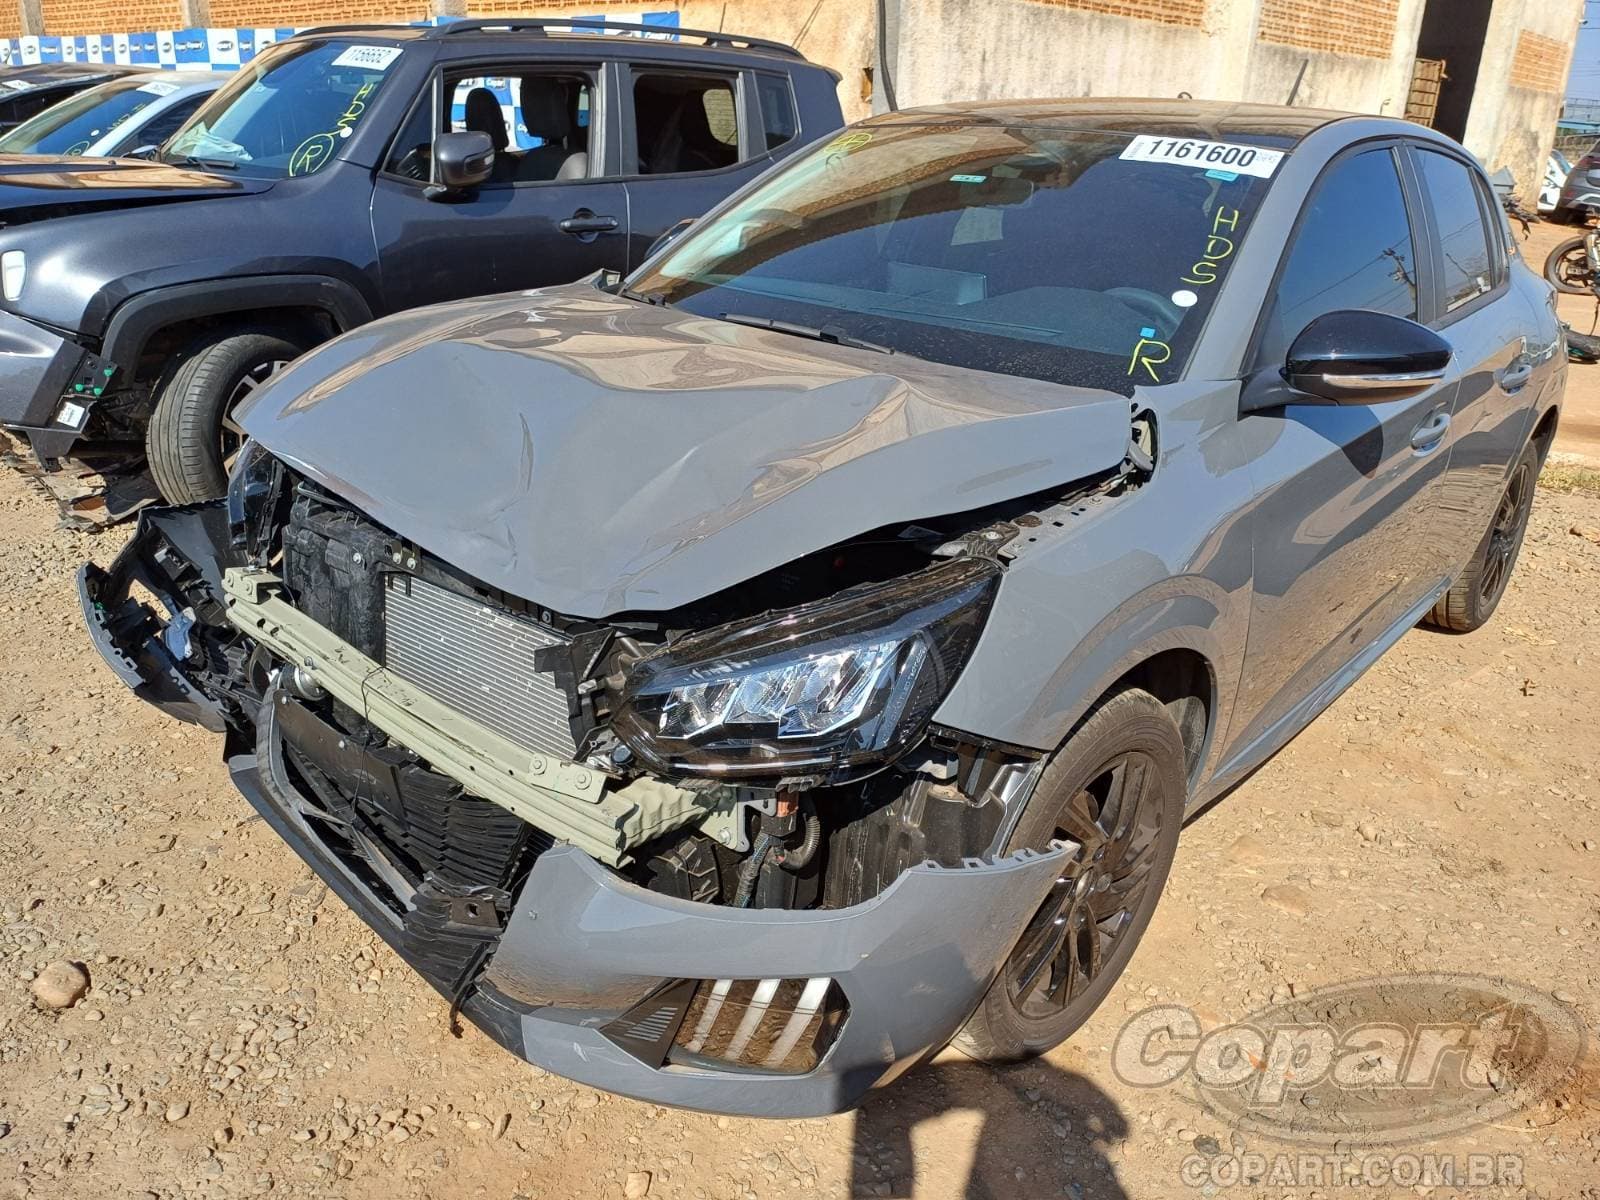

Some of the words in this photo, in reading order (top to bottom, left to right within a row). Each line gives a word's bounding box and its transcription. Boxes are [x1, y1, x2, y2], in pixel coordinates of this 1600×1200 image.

[293, 145, 323, 176] R
[1149, 139, 1257, 167] 1161600
[1180, 205, 1239, 284] HDS
[1127, 338, 1171, 383] R
